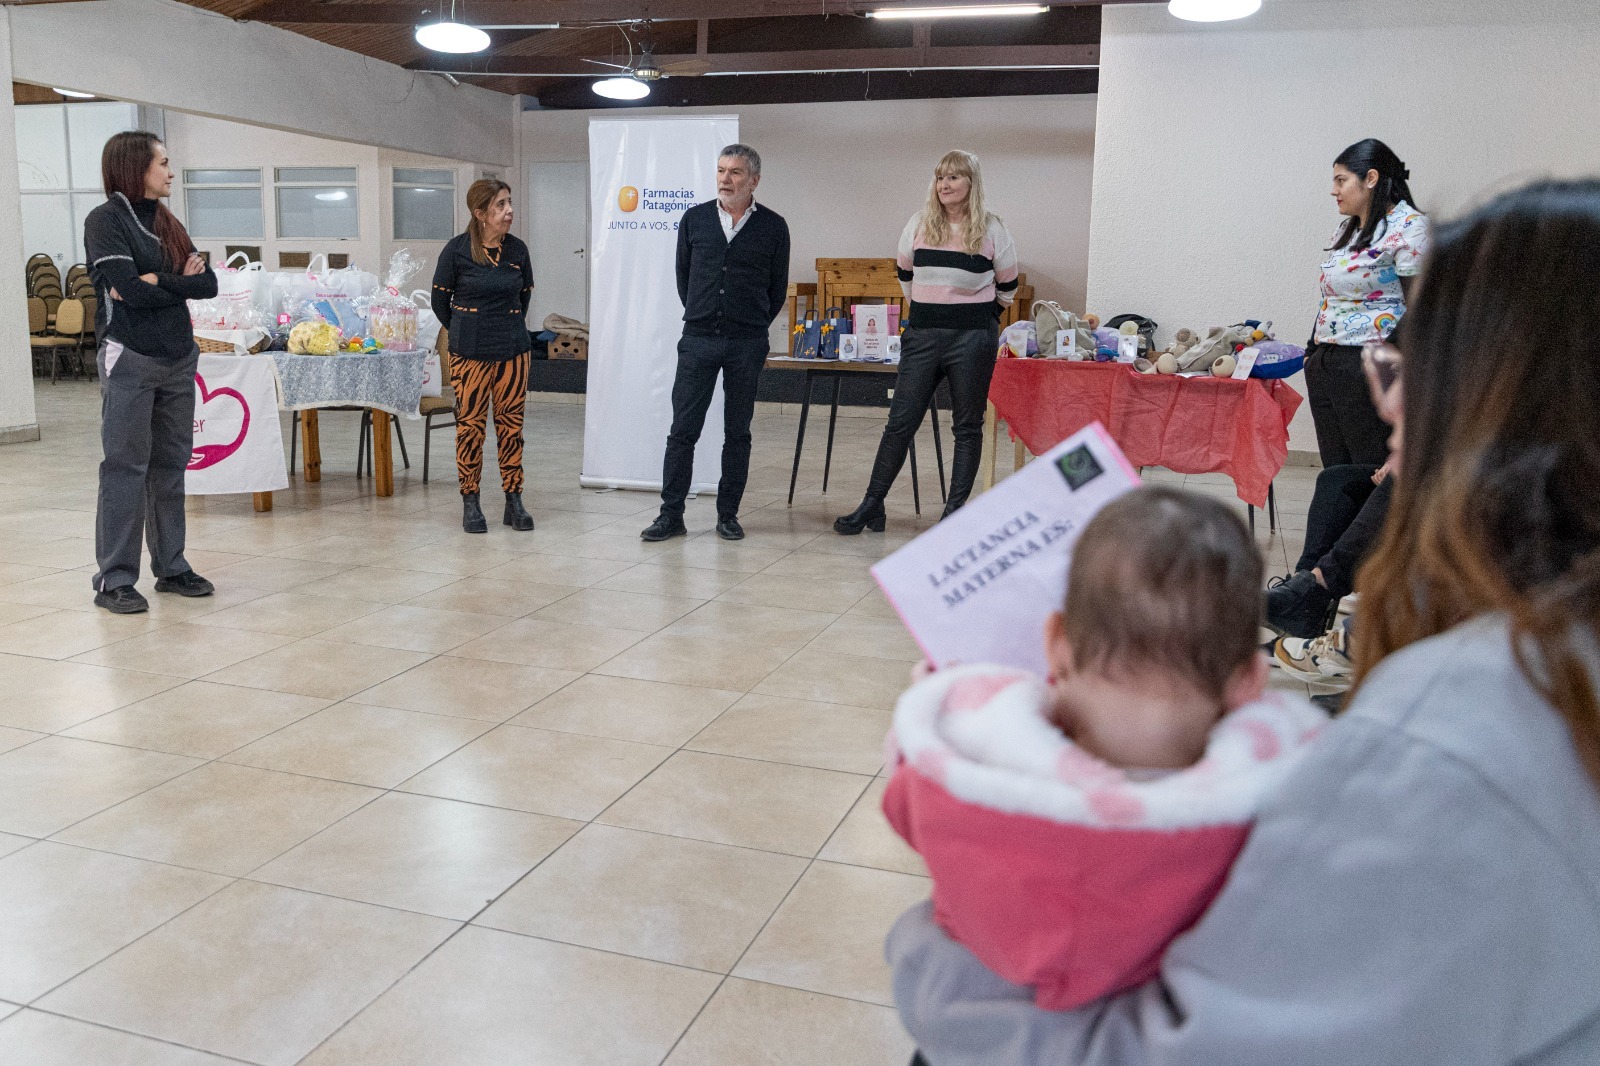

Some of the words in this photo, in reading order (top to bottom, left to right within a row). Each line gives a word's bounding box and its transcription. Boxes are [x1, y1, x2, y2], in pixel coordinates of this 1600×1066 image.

[643, 188, 695, 199] Farmacias
[607, 221, 638, 230] JUNTO
[640, 221, 647, 230] A
[648, 221, 671, 232] VOS,
[928, 510, 1040, 588] LACTANCIA
[942, 539, 1041, 609] MATERNA
